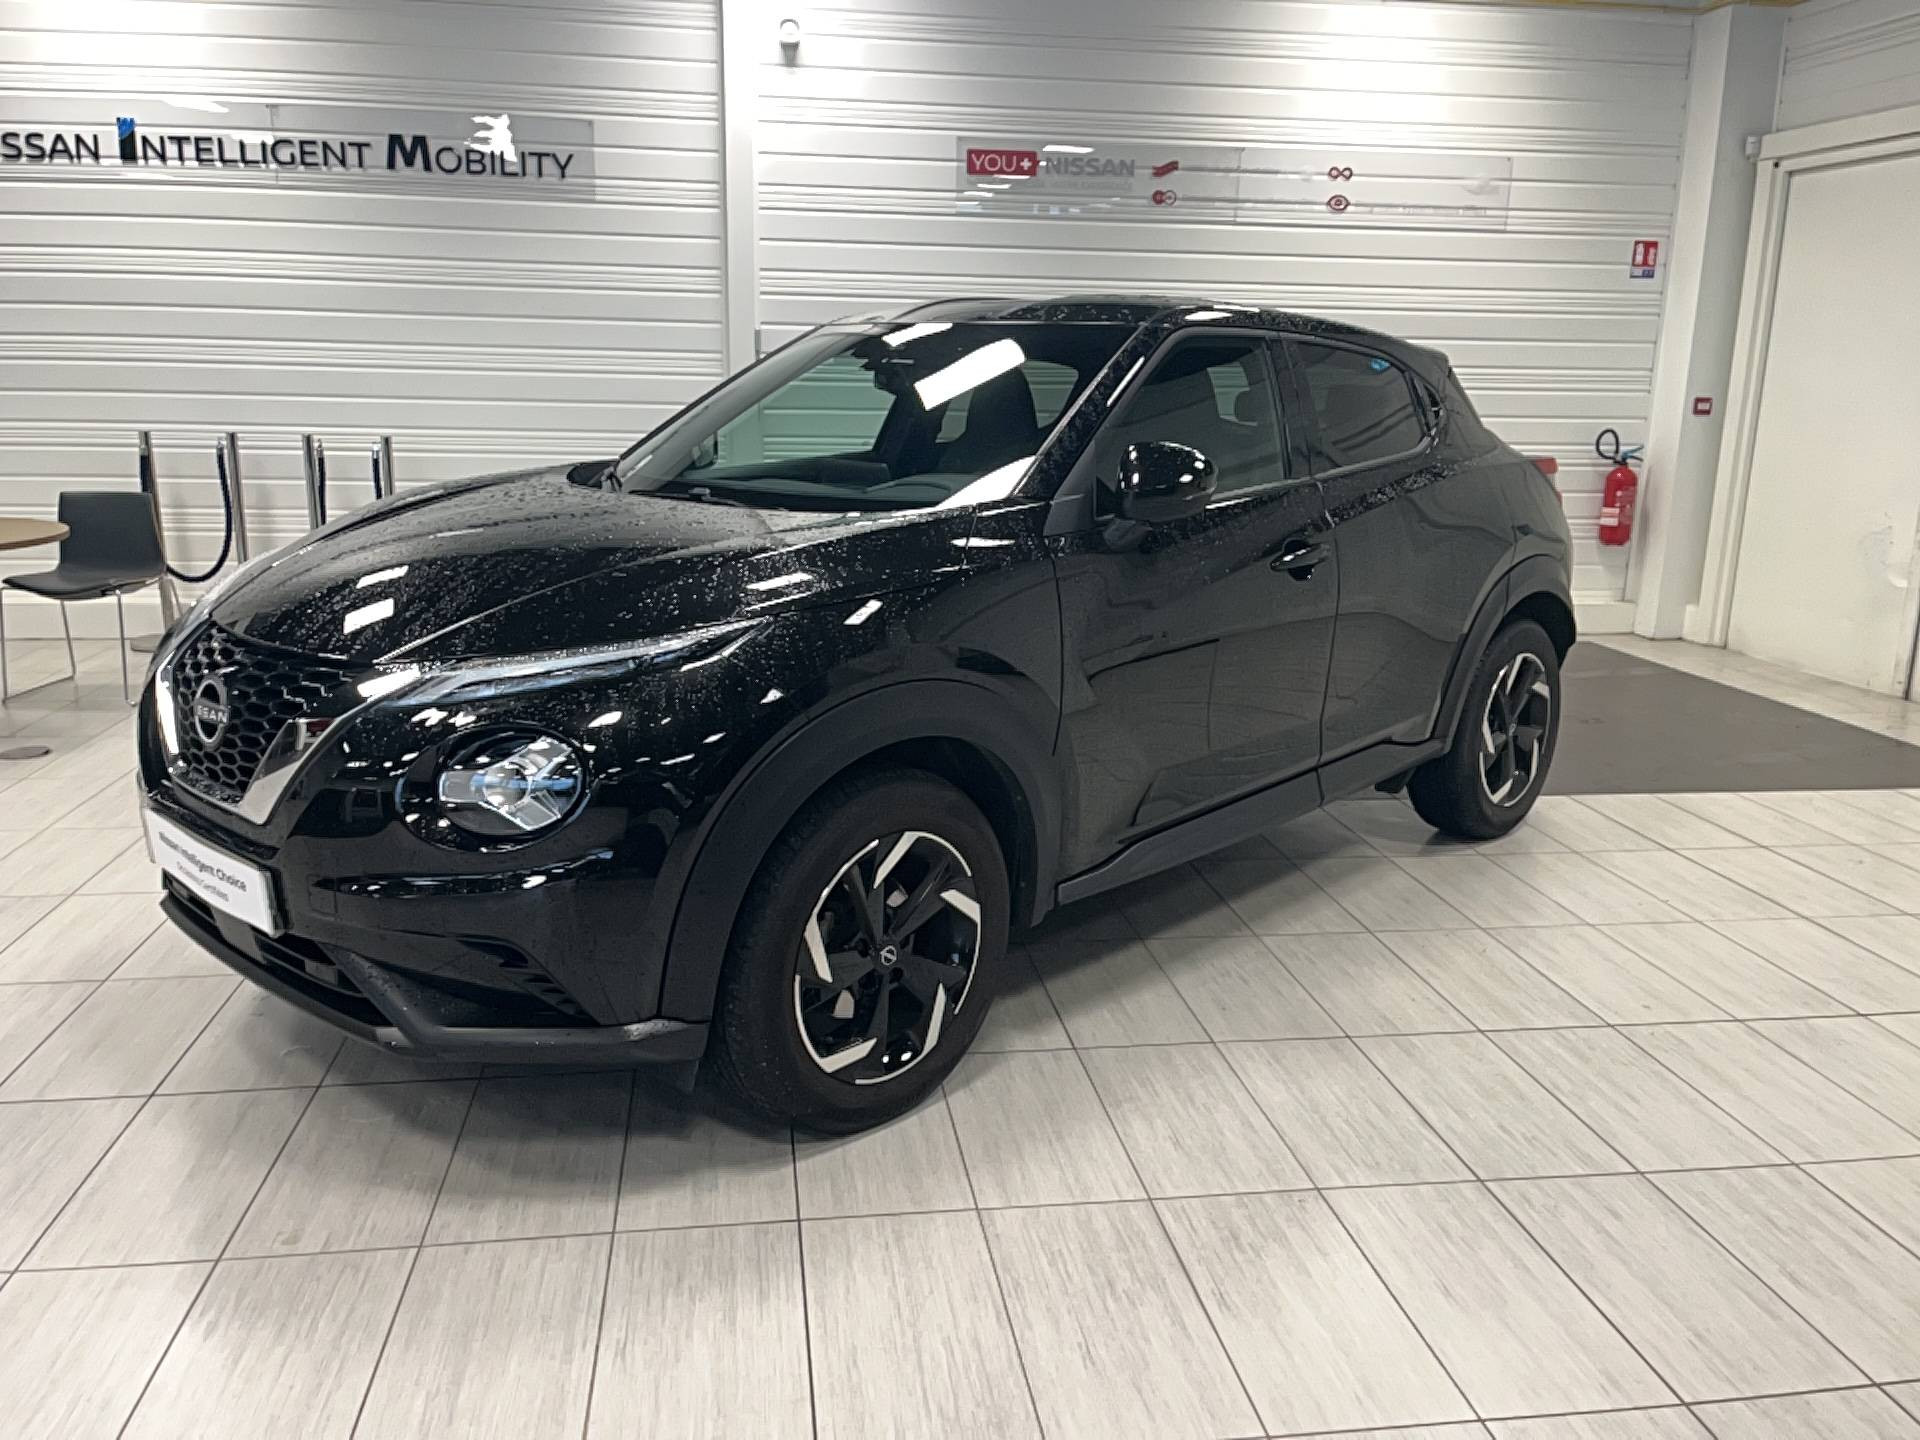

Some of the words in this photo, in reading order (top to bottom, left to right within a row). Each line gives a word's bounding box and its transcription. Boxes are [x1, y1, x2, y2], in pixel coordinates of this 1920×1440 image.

[116, 117, 371, 169] INTELLIGENT
[386, 133, 575, 179] MOBILITY
[1045, 156, 1136, 177] NISSAN
